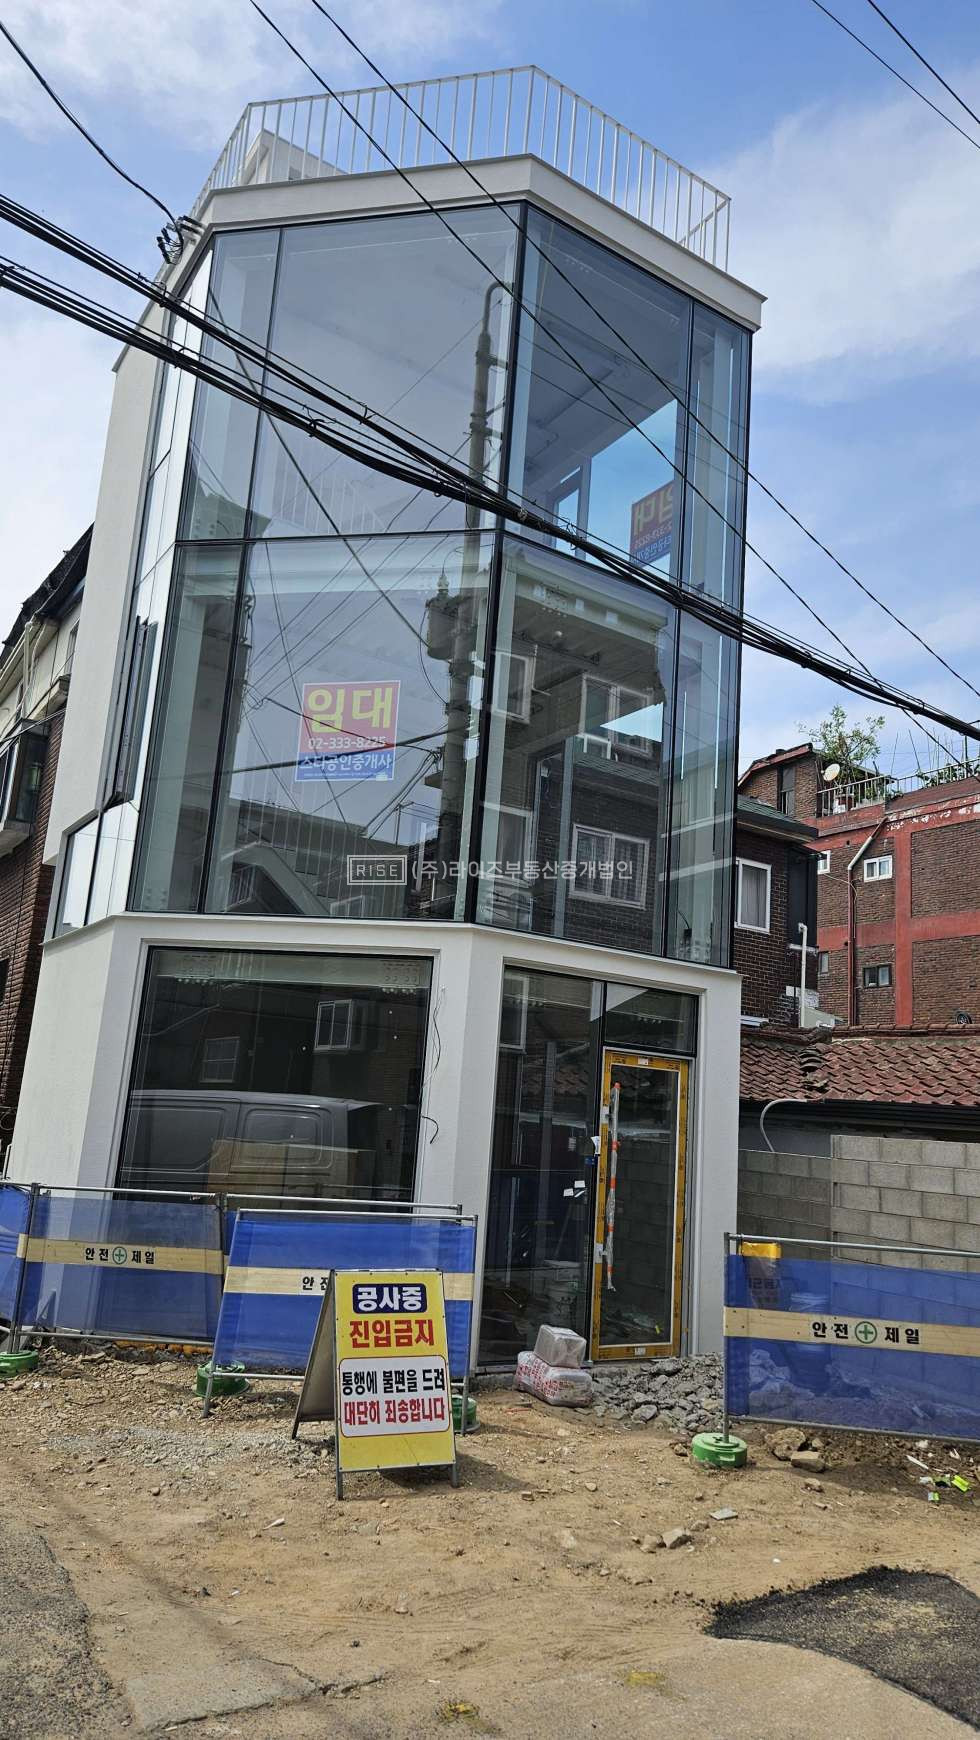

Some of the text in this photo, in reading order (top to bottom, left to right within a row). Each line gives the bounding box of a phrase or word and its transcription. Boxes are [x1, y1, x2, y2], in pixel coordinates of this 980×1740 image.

[308, 688, 393, 733] 임대
[357, 1286, 422, 1312] 공사중
[349, 1319, 434, 1348] 진입금지
[342, 1368, 445, 1396] 통행에 불편을 드려
[344, 1397, 445, 1426] 대단히 죄송합니다
